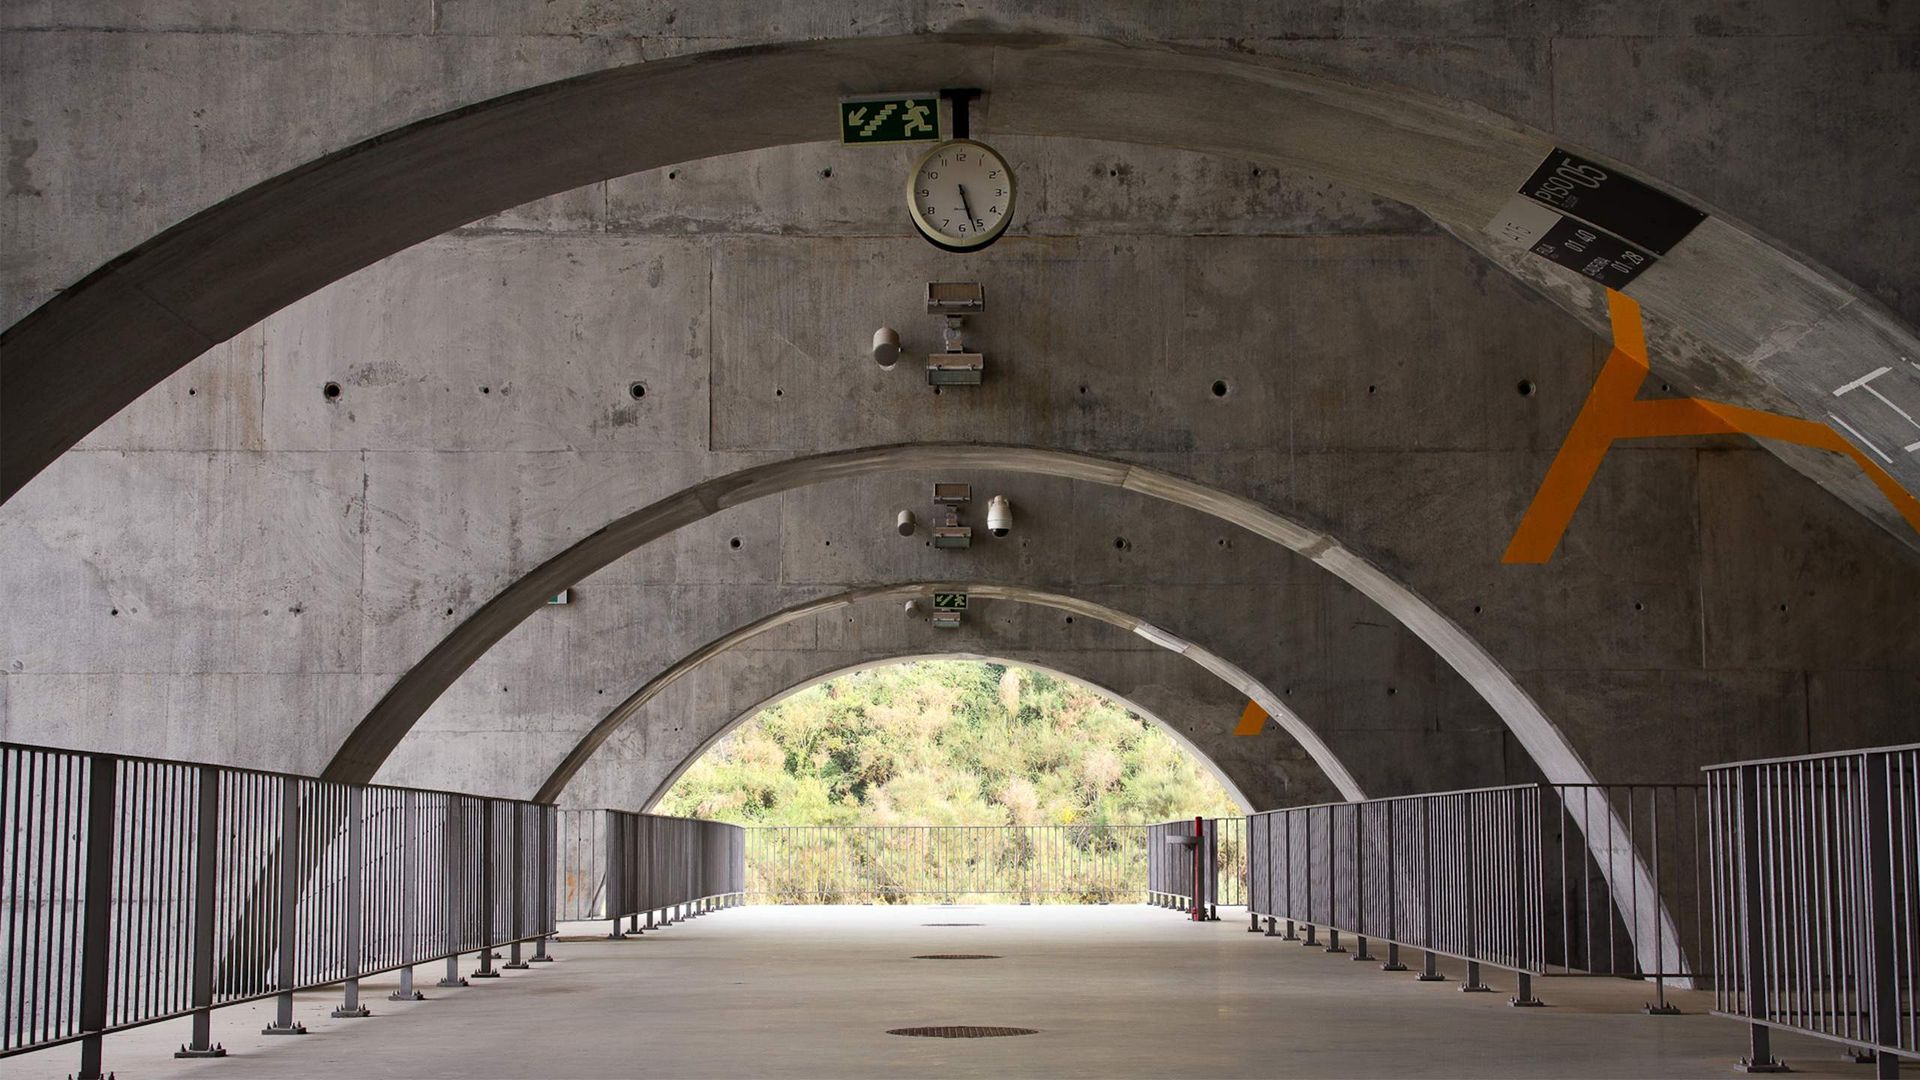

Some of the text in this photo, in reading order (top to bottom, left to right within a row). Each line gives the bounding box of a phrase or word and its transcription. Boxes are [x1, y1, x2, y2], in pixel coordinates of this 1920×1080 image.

[956, 154, 966, 162] 12
[928, 172, 938, 180] 10
[988, 171, 996, 179] 2
[1535, 176, 1574, 205] PISO
[1556, 158, 1607, 188] 05
[976, 219, 984, 227] 5
[959, 224, 966, 232] 6
[1564, 229, 1597, 252] 01 40
[1611, 250, 1644, 273] 01 28
